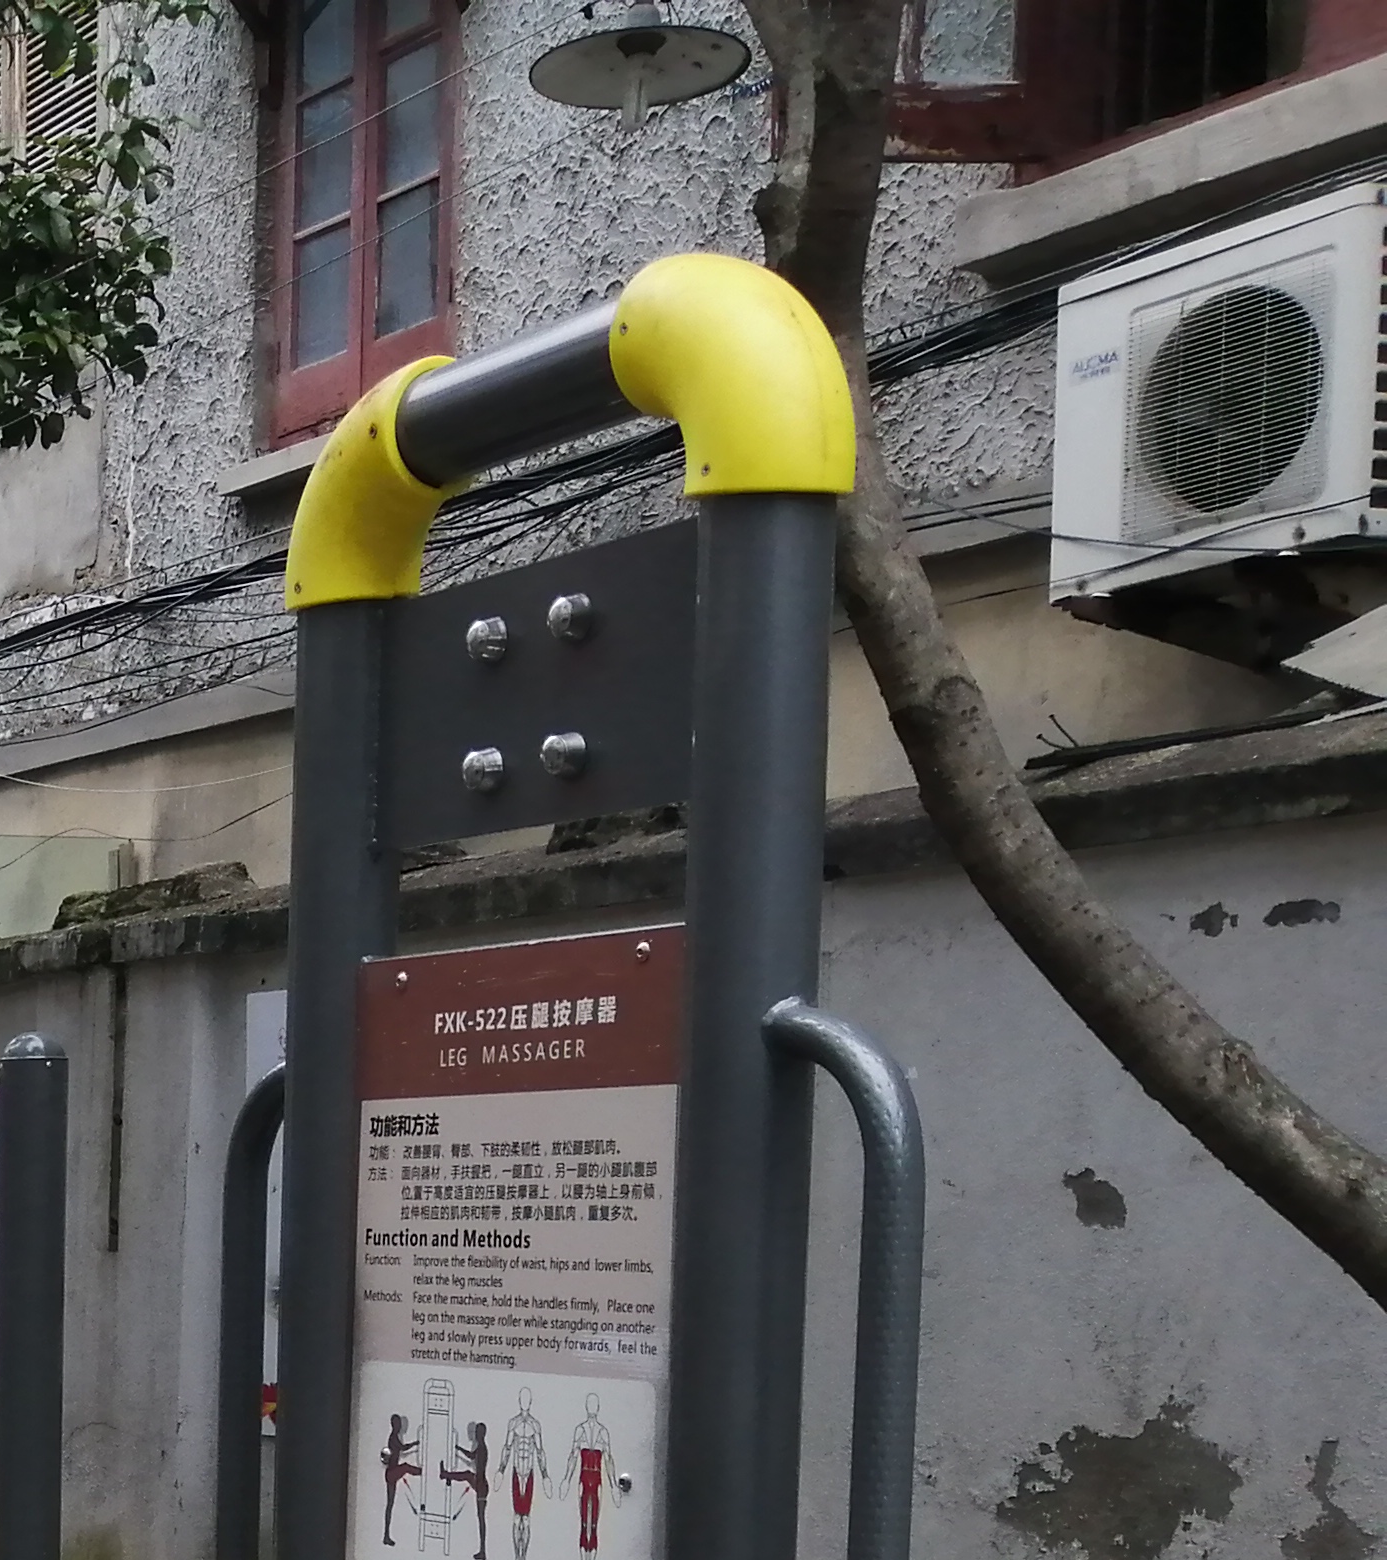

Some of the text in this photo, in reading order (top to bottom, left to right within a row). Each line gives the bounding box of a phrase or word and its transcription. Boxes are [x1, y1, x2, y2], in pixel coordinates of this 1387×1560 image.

[433, 995, 618, 1035] FXK-522压腿按摩器
[439, 1039, 586, 1068] LEG MASSAGER
[368, 1112, 440, 1138] 功能和方法
[364, 1227, 531, 1249] Function and Methods
[412, 1254, 449, 1270] Improve
[450, 1254, 465, 1268] the
[466, 1255, 508, 1271] flexibility
[508, 1256, 520, 1270] of
[548, 1257, 570, 1273] hips
[571, 1257, 590, 1272] and
[594, 1257, 622, 1272] lower
[412, 1272, 503, 1289] relax the leg muscles
[412, 1291, 433, 1305] Face
[433, 1291, 449, 1306] the
[490, 1294, 513, 1309] hold
[513, 1294, 530, 1310] the
[531, 1295, 569, 1311] handles
[606, 1298, 634, 1314] Place
[635, 1299, 655, 1315] one
[411, 1309, 655, 1336] leg on the massage roller while stangding on another
[410, 1327, 425, 1343] leg
[426, 1328, 445, 1343] and
[446, 1329, 477, 1347] slowly
[477, 1331, 504, 1348] press
[505, 1332, 534, 1350] upper
[535, 1334, 562, 1352] body
[617, 1339, 638, 1354] feel
[639, 1340, 657, 1356] the
[410, 1346, 440, 1360] stretch
[441, 1348, 451, 1361] of
[452, 1349, 467, 1362] the
